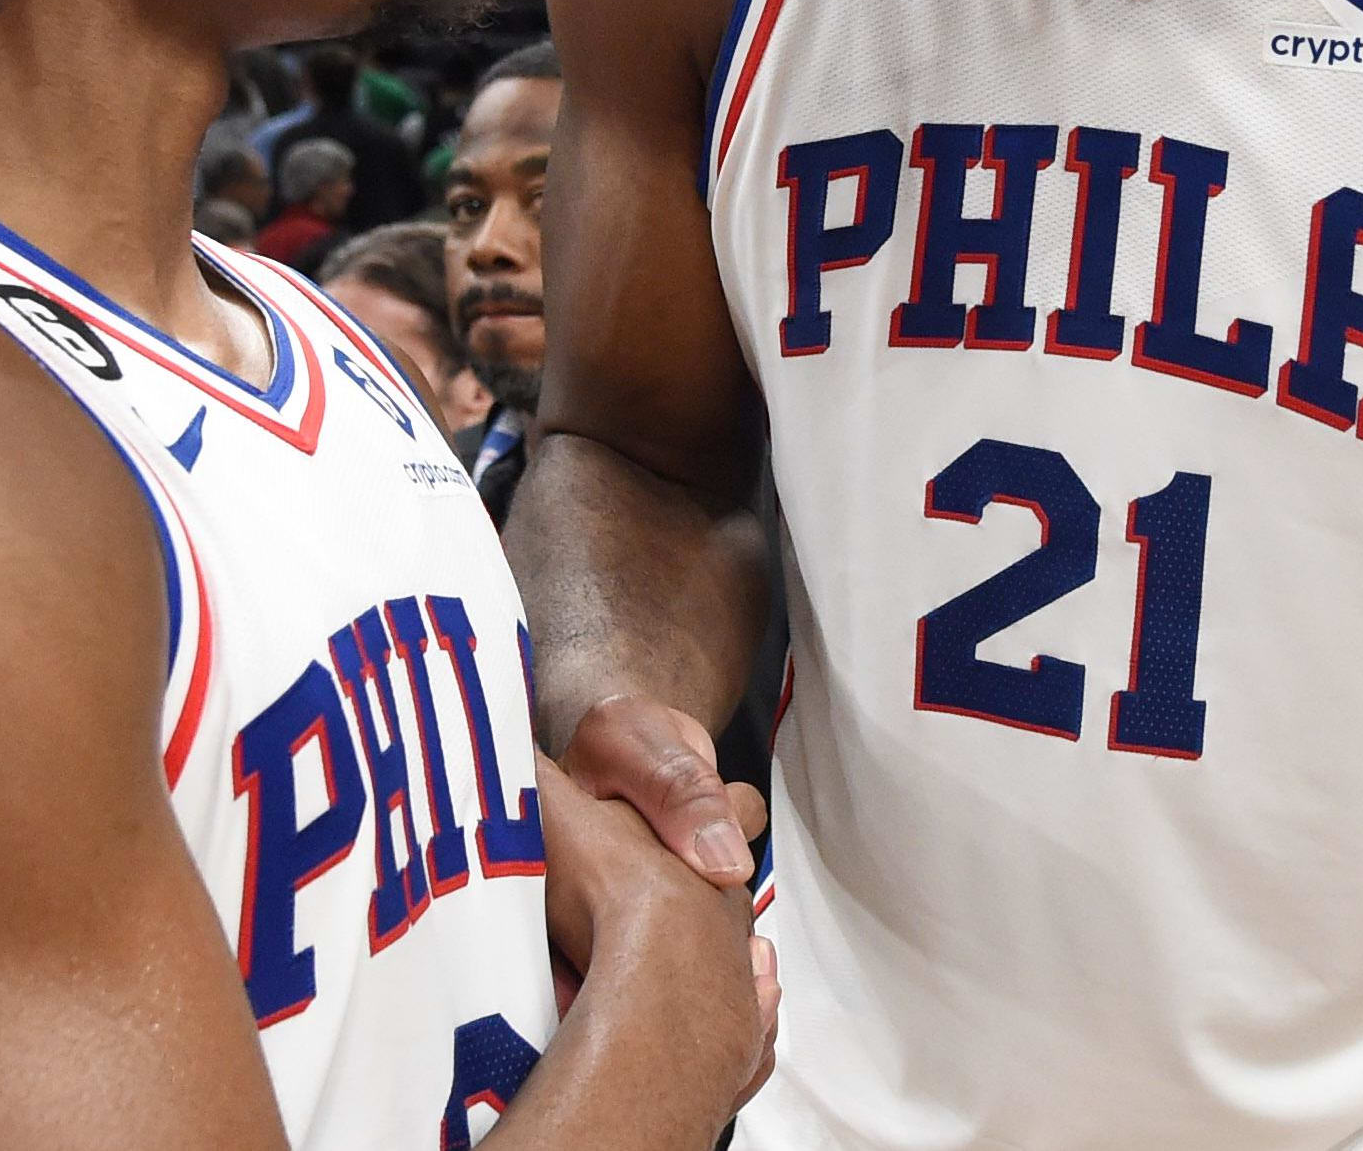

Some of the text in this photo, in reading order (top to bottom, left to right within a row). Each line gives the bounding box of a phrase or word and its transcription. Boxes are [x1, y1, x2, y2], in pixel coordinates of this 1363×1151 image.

[7, 296, 109, 369] 6
[913, 437, 1212, 761] 21
[232, 593, 546, 1031] PHIL
